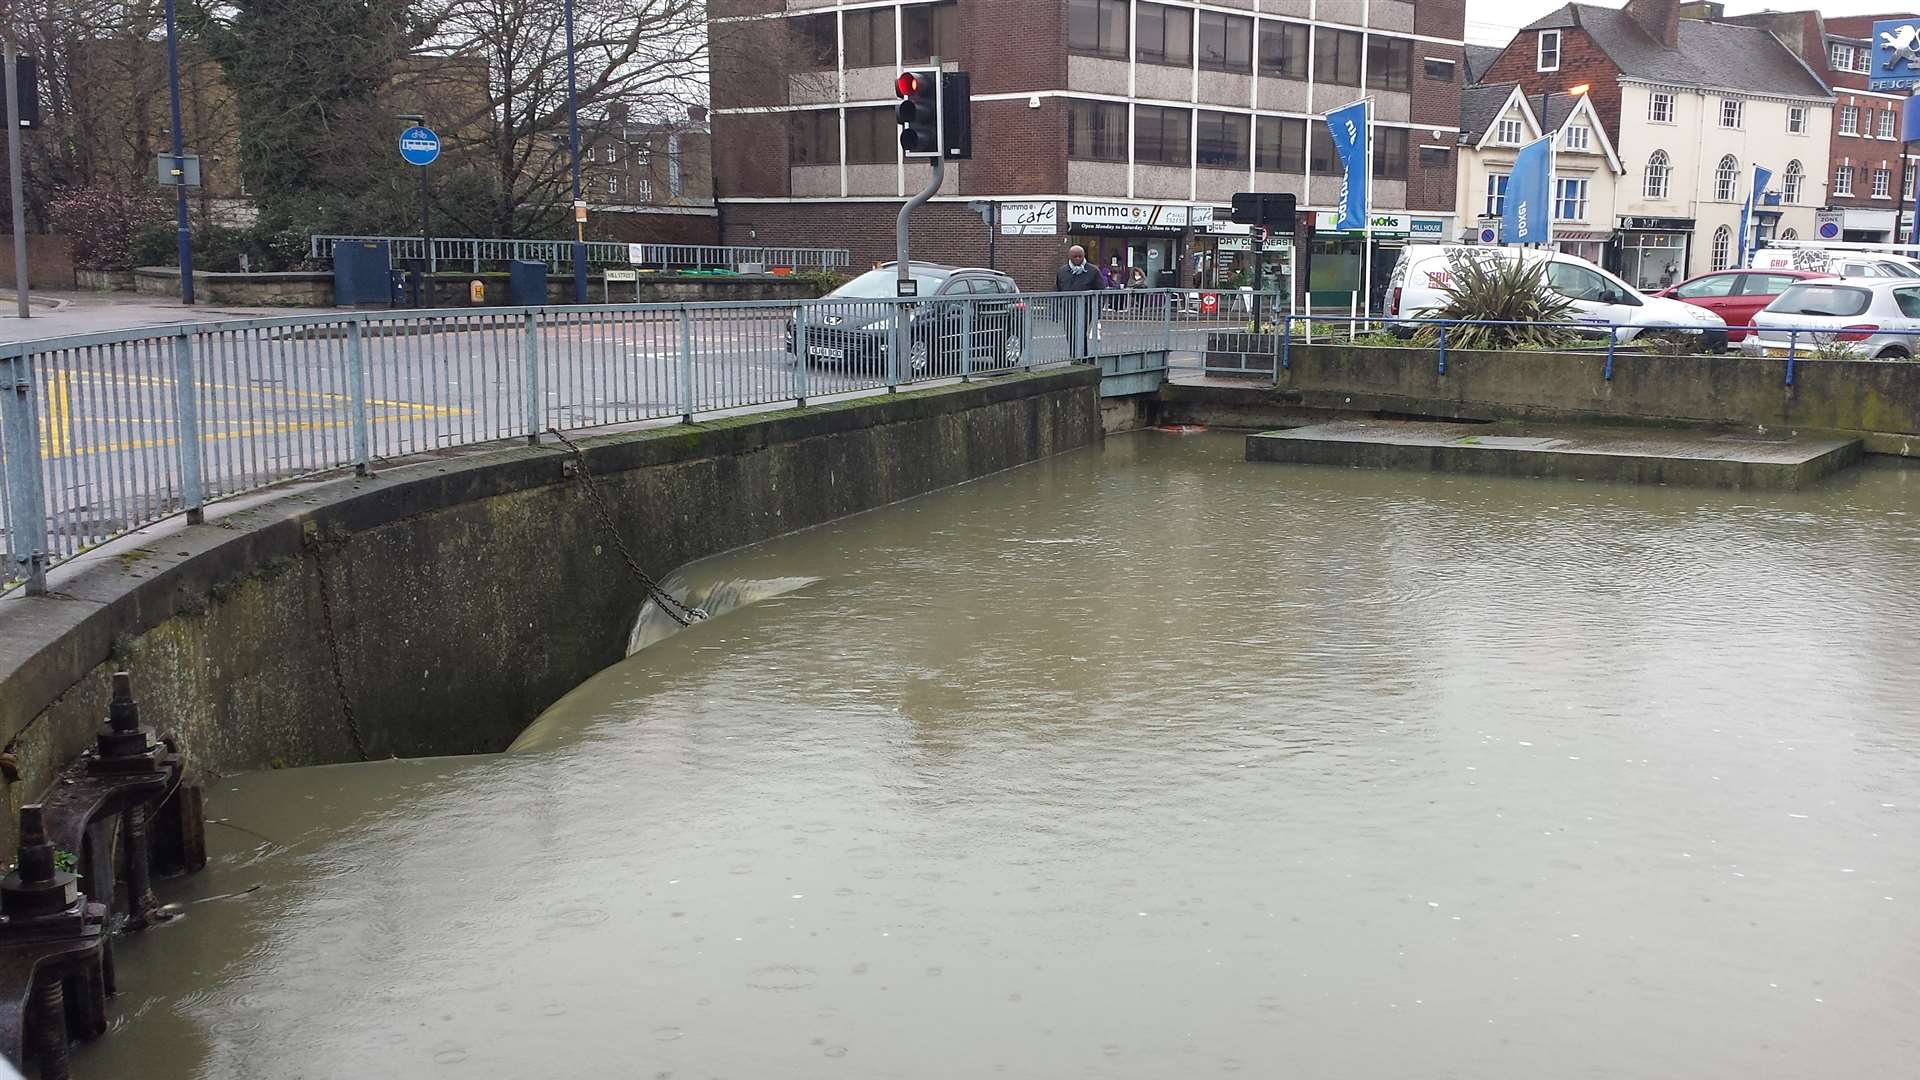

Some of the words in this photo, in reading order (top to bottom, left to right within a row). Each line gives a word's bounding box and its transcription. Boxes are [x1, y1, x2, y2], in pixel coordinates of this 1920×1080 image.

[1872, 80, 1914, 90] PEUGE
[1072, 204, 1128, 217] mumma
[1411, 223, 1425, 231] MILL
[1426, 223, 1441, 231] HOUSE
[1770, 259, 1789, 267] GRIP
